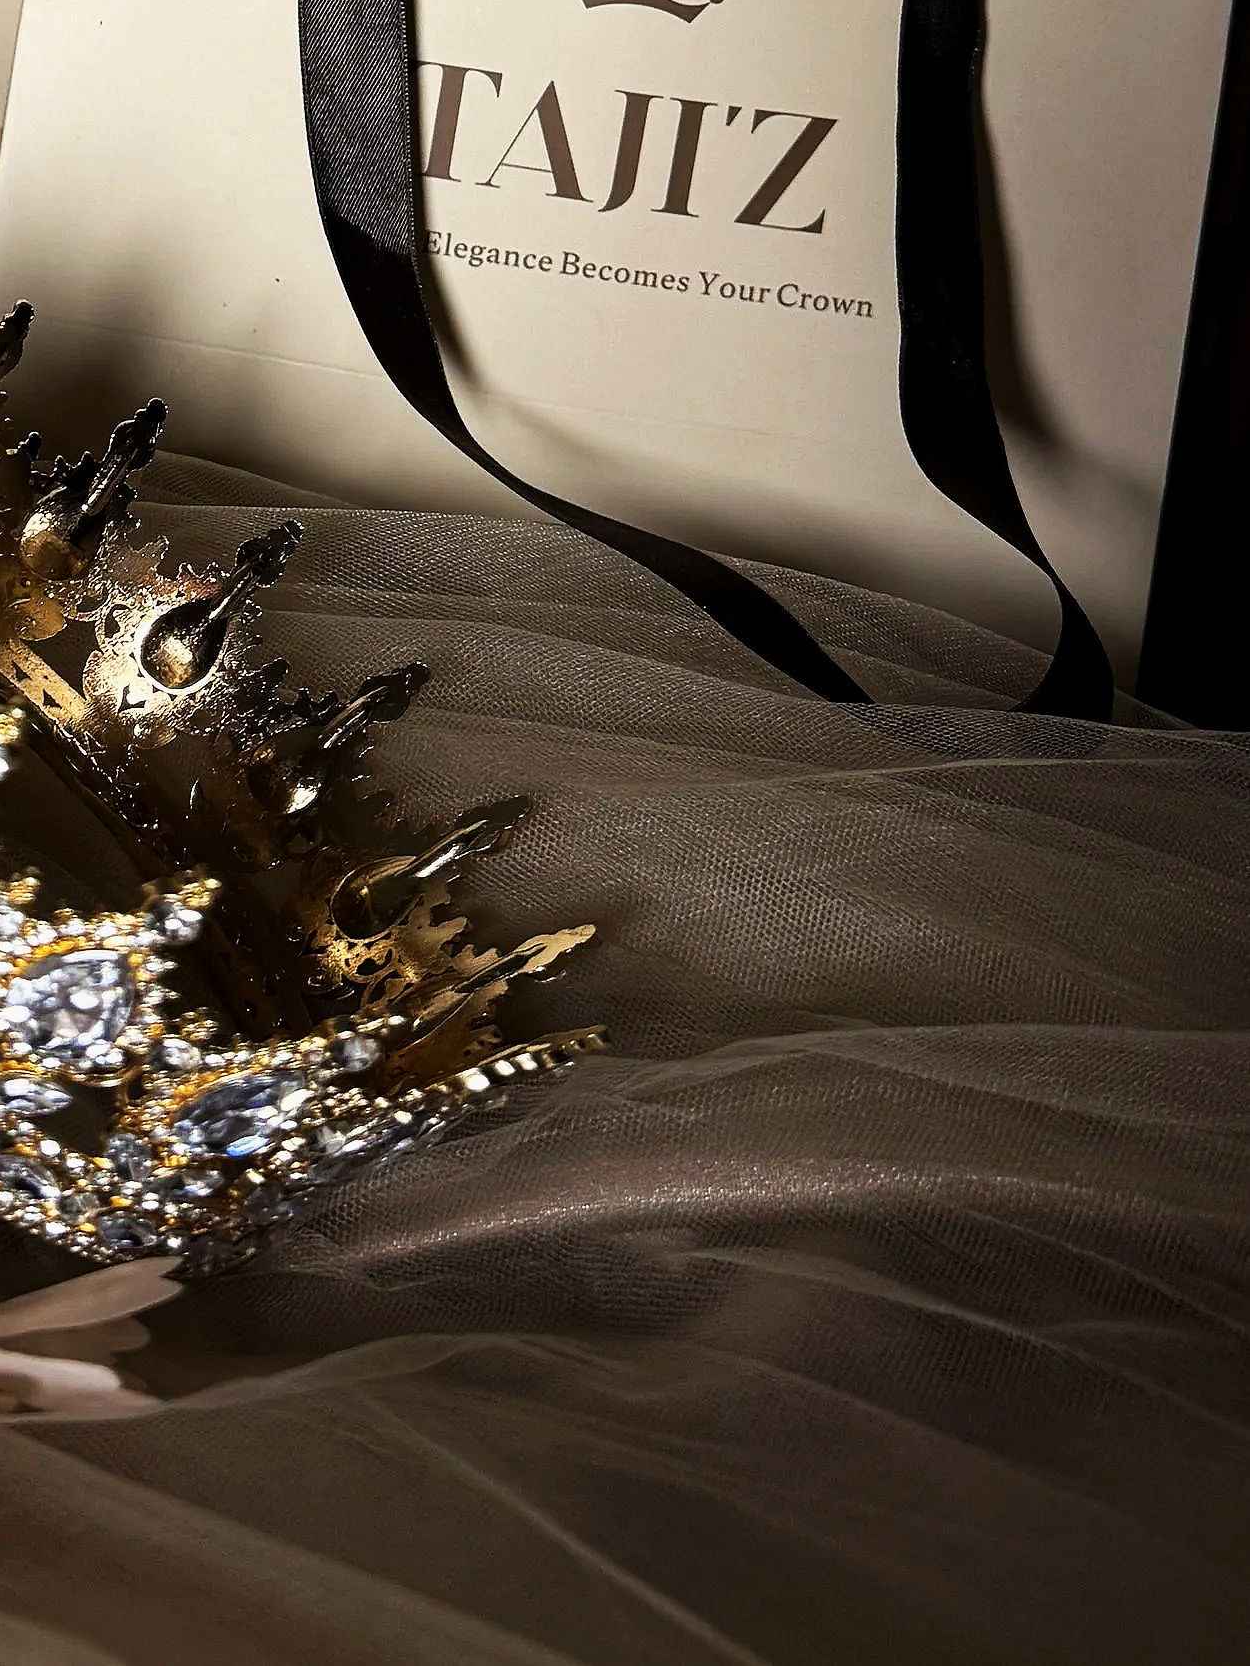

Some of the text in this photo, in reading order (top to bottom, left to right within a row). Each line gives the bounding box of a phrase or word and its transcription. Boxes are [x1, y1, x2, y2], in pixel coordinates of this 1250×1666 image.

[415, 60, 839, 235] TAJI'Z
[424, 230, 874, 320] Elegance Becomes Your Crown
